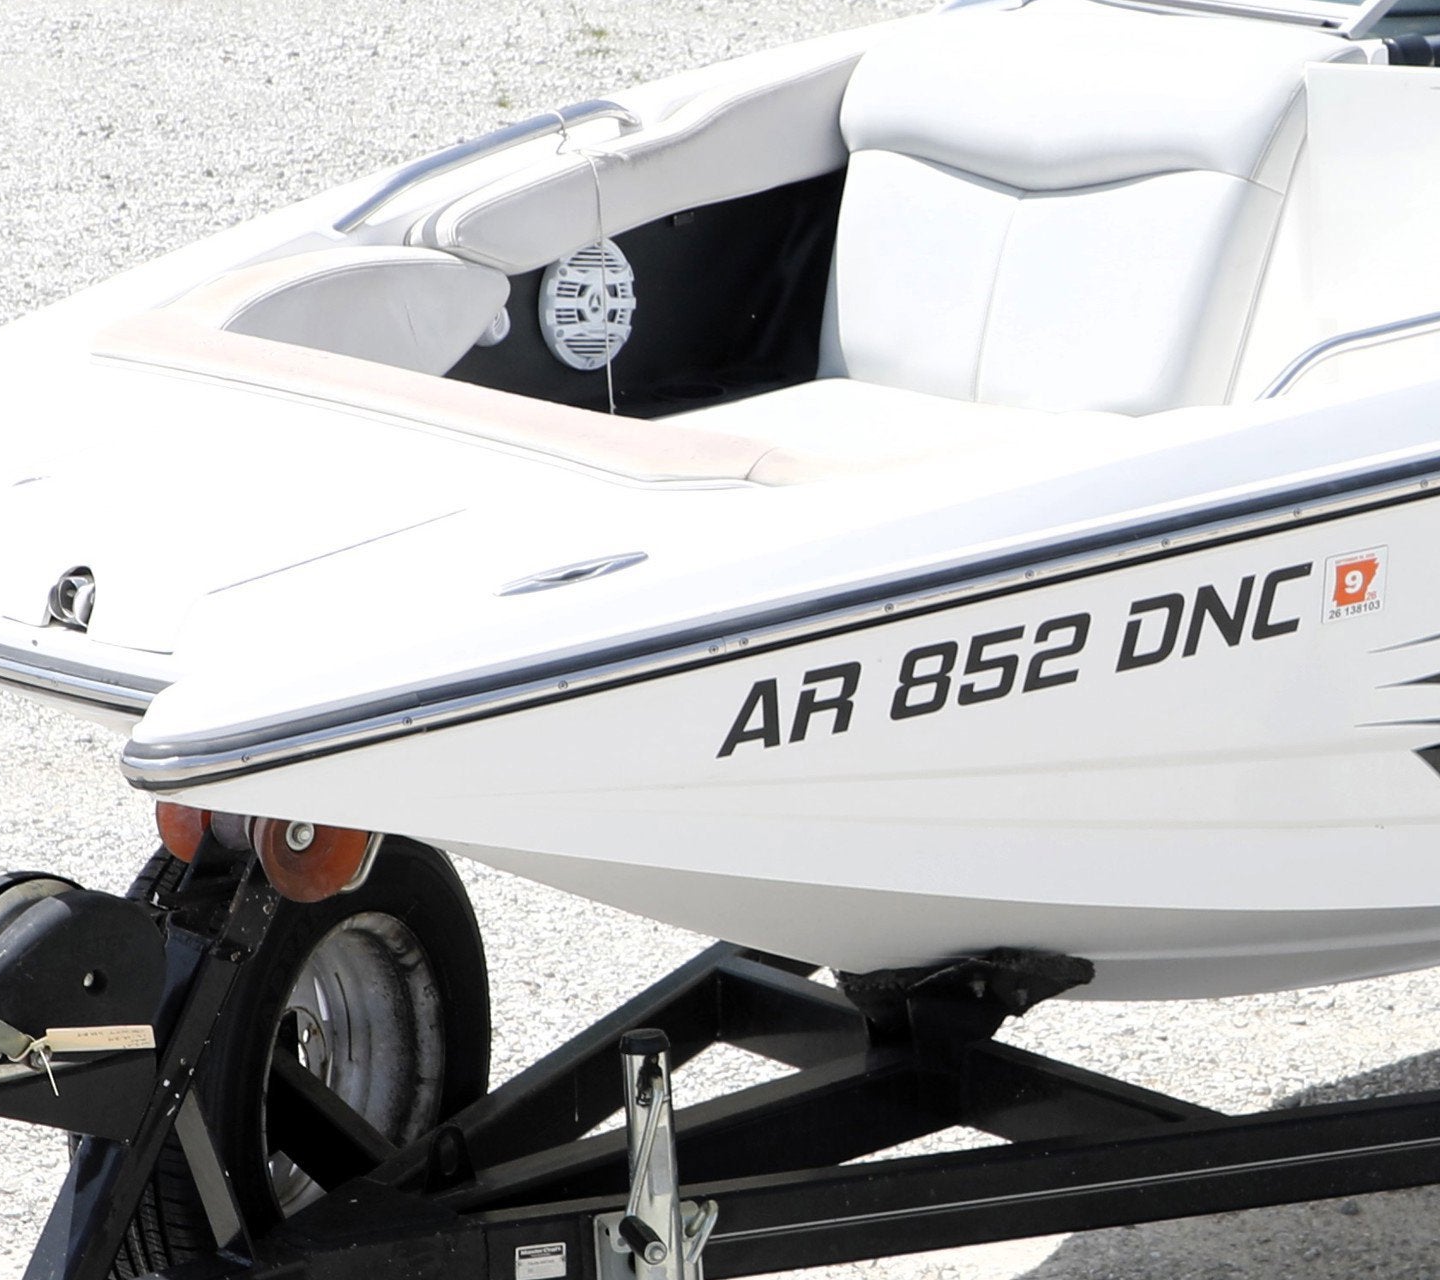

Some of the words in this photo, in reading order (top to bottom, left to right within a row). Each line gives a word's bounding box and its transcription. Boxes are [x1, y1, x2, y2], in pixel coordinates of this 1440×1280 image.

[1344, 569, 1364, 595] 9
[1328, 608, 1341, 620] 26
[1345, 600, 1381, 616] 138103
[715, 661, 862, 759] AR
[889, 611, 1092, 722] 852
[1115, 561, 1314, 673] DNC
